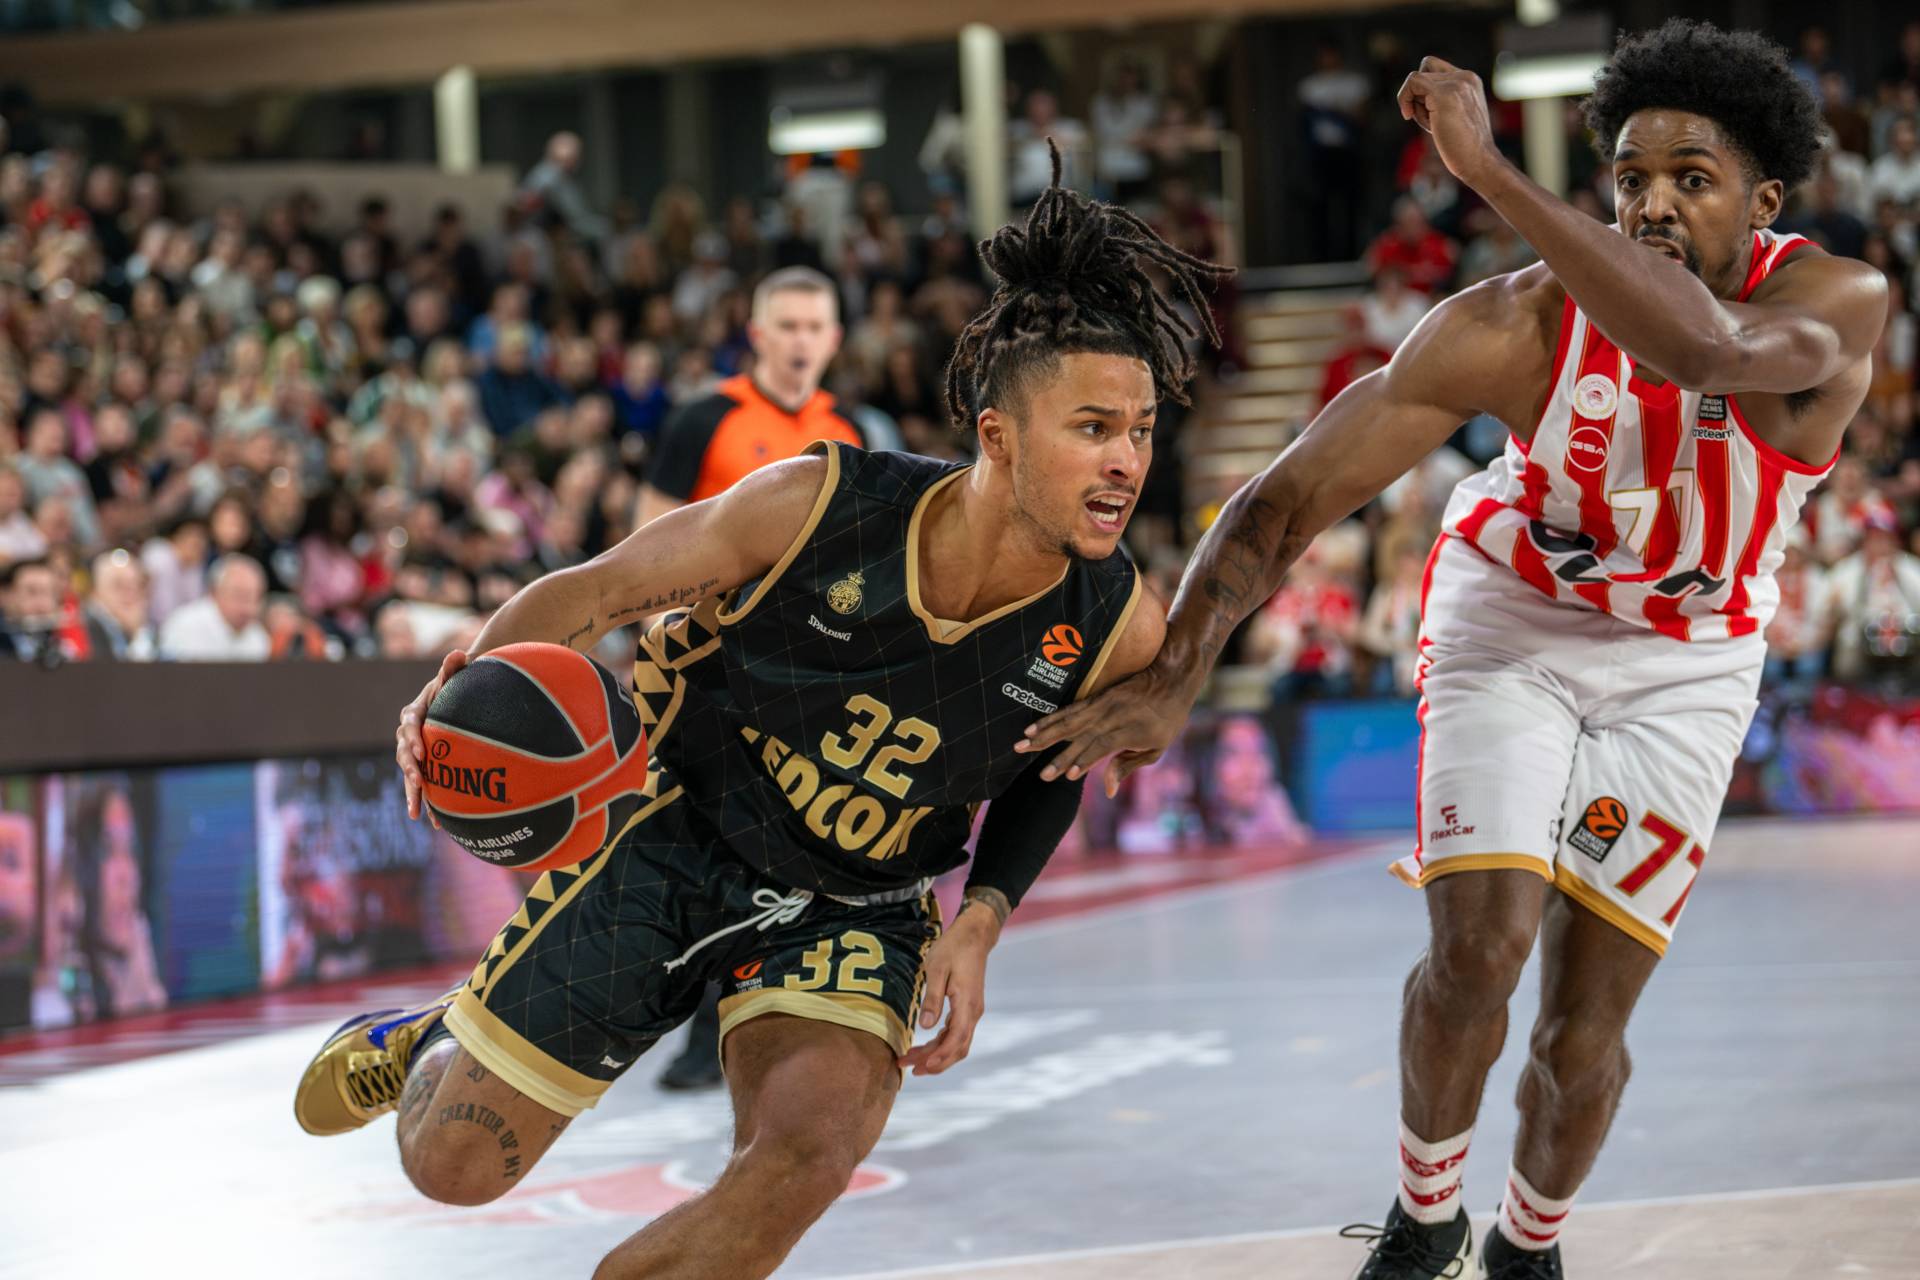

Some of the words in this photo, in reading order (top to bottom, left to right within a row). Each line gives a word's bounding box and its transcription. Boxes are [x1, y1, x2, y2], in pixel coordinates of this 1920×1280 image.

[807, 614, 852, 641] SPALDING
[1030, 664, 1066, 684] AIRLINES
[1034, 656, 1069, 678] TURKISH
[1002, 682, 1058, 714] oneteam
[820, 694, 942, 800] 32
[477, 826, 534, 849] AIRLINES
[784, 930, 885, 996] 32
[439, 1103, 505, 1135] CREATOR
[499, 1130, 519, 1151] OF
[503, 1155, 521, 1178] MY
